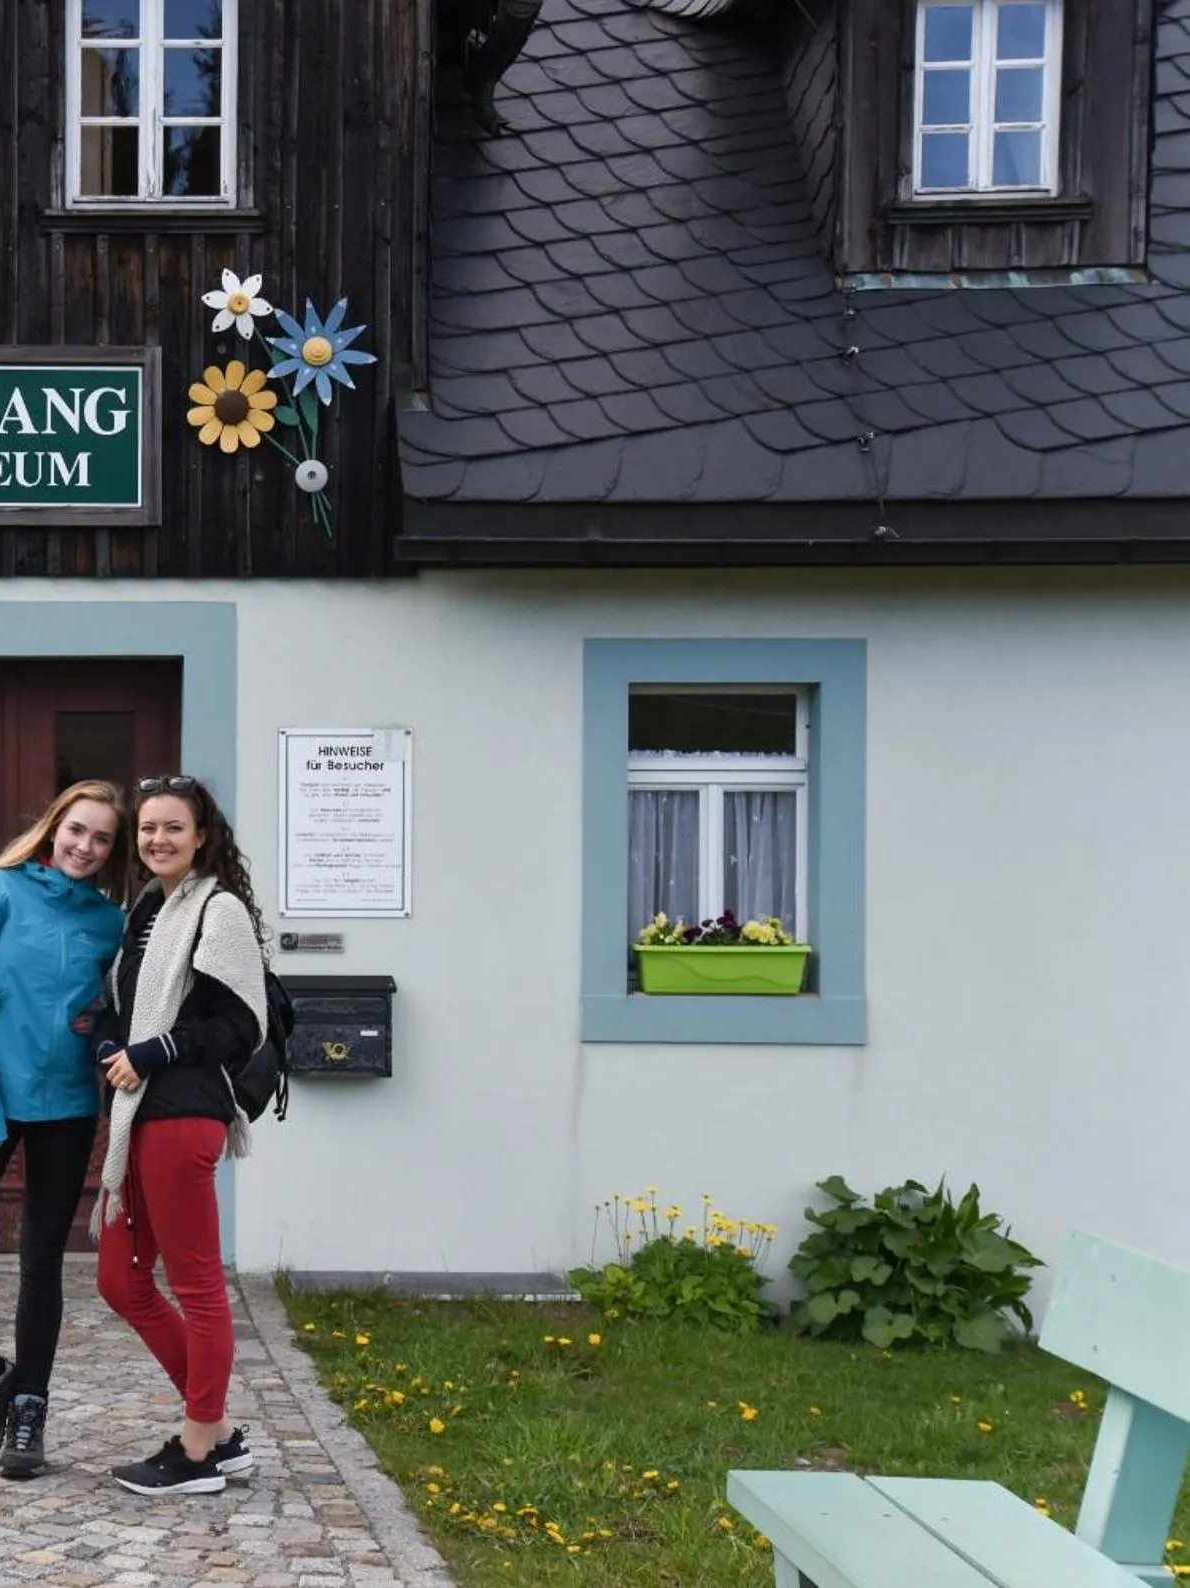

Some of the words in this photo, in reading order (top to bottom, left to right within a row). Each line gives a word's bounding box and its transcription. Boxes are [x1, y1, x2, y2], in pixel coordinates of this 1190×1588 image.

[318, 746, 372, 757] HINWEISE
[306, 760, 322, 771] für
[327, 760, 385, 771] Besucher
